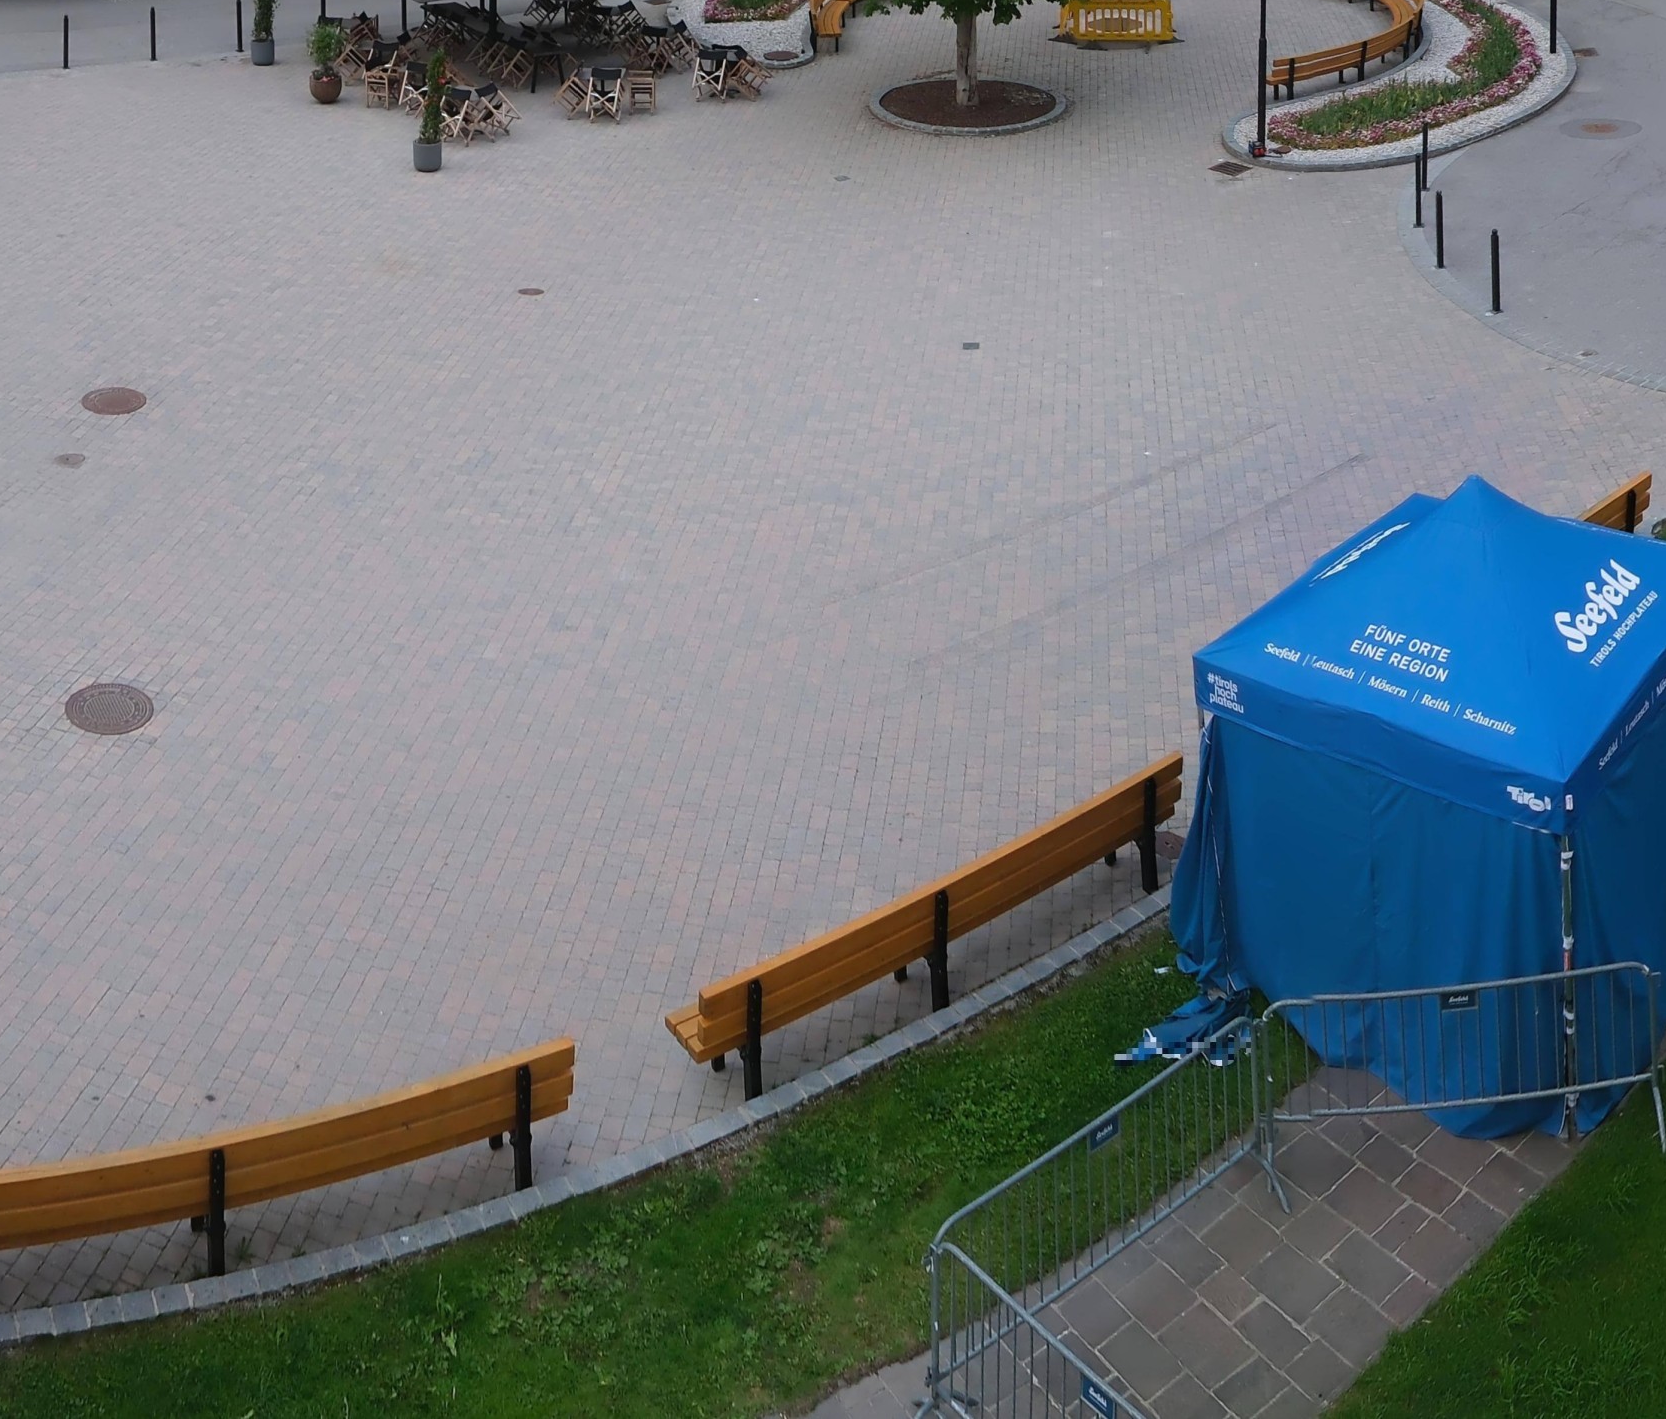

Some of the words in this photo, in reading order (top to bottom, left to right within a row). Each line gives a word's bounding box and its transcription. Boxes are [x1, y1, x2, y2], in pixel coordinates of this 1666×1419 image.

[1554, 558, 1641, 654] Seefeld
[1364, 623, 1407, 649] FÜNF
[1408, 638, 1451, 663] ORTE
[1589, 638, 1617, 668] TIROLS
[1614, 590, 1659, 640] HOCHPLATEAU
[1349, 639, 1384, 662] EINE
[1388, 652, 1449, 683] REGION
[1207, 671, 1238, 693] #tirols
[1214, 684, 1237, 701] hoch
[1264, 642, 1300, 663] Seefeld
[1367, 675, 1408, 698] Mösern
[1421, 693, 1451, 713] Reith
[1463, 707, 1517, 735] Scharnitz
[1209, 693, 1244, 714] plateau
[1507, 785, 1552, 812] Tirol
